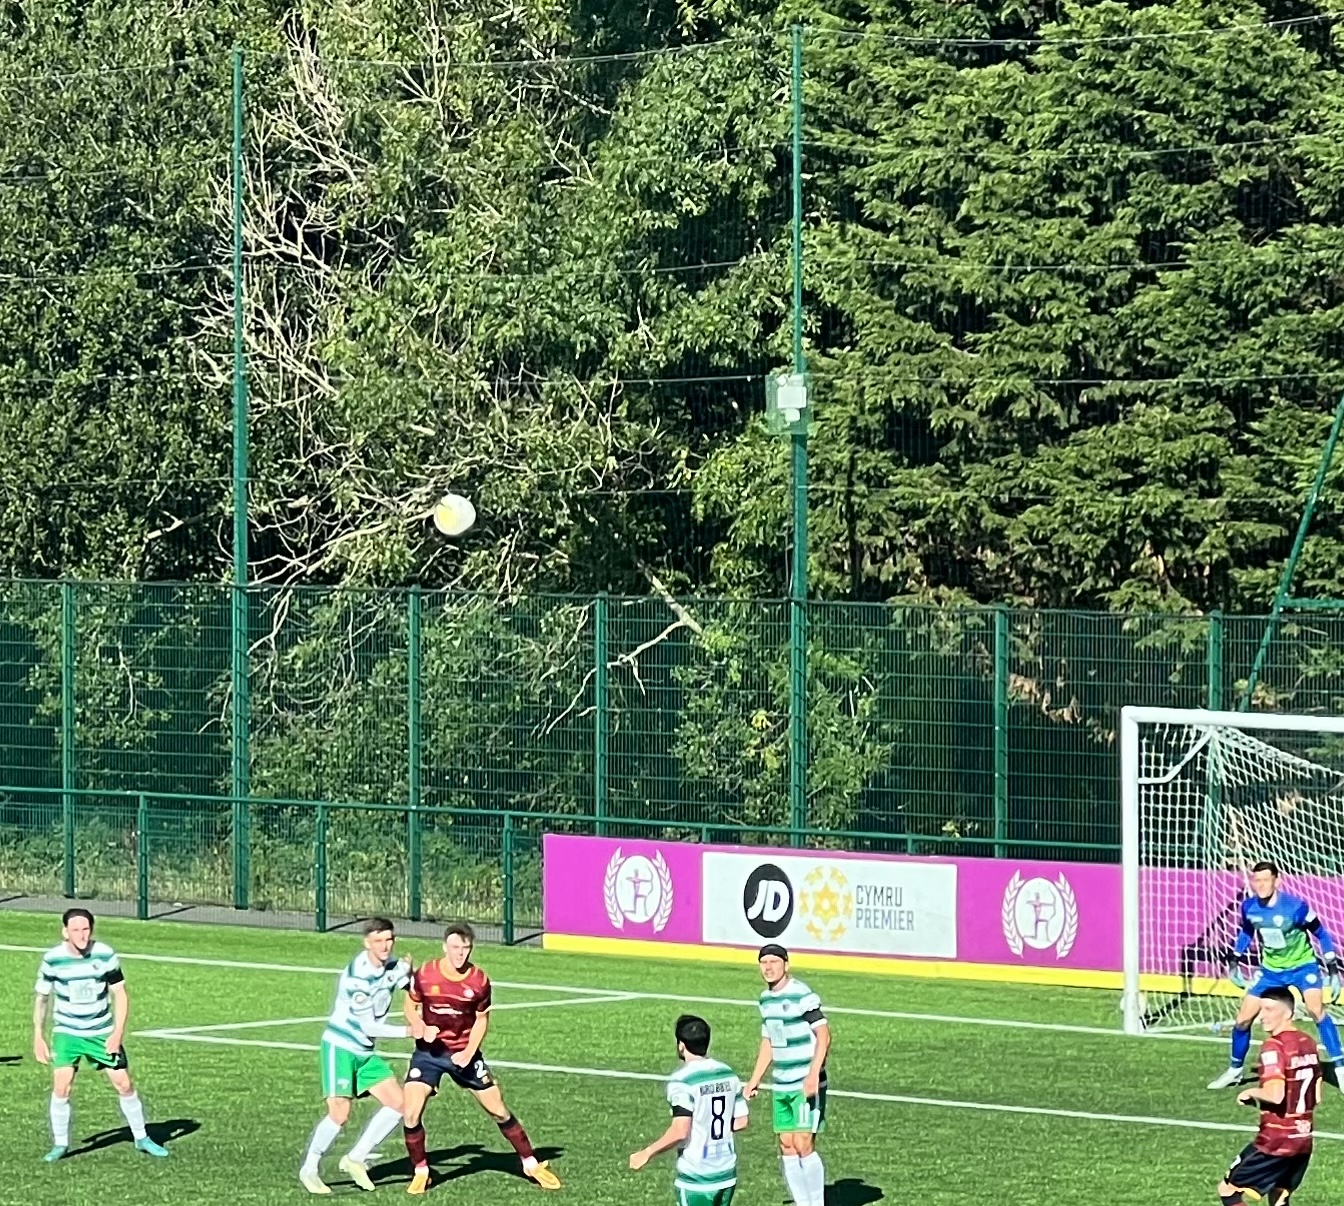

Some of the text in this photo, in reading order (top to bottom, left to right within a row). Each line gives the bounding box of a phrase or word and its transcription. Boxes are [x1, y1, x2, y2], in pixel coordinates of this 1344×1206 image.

[747, 879, 790, 922] JD
[856, 885, 903, 907] CYMRU
[856, 908, 915, 931] PREMIER
[1295, 1067, 1314, 1114] 7
[711, 1096, 726, 1140] 8
